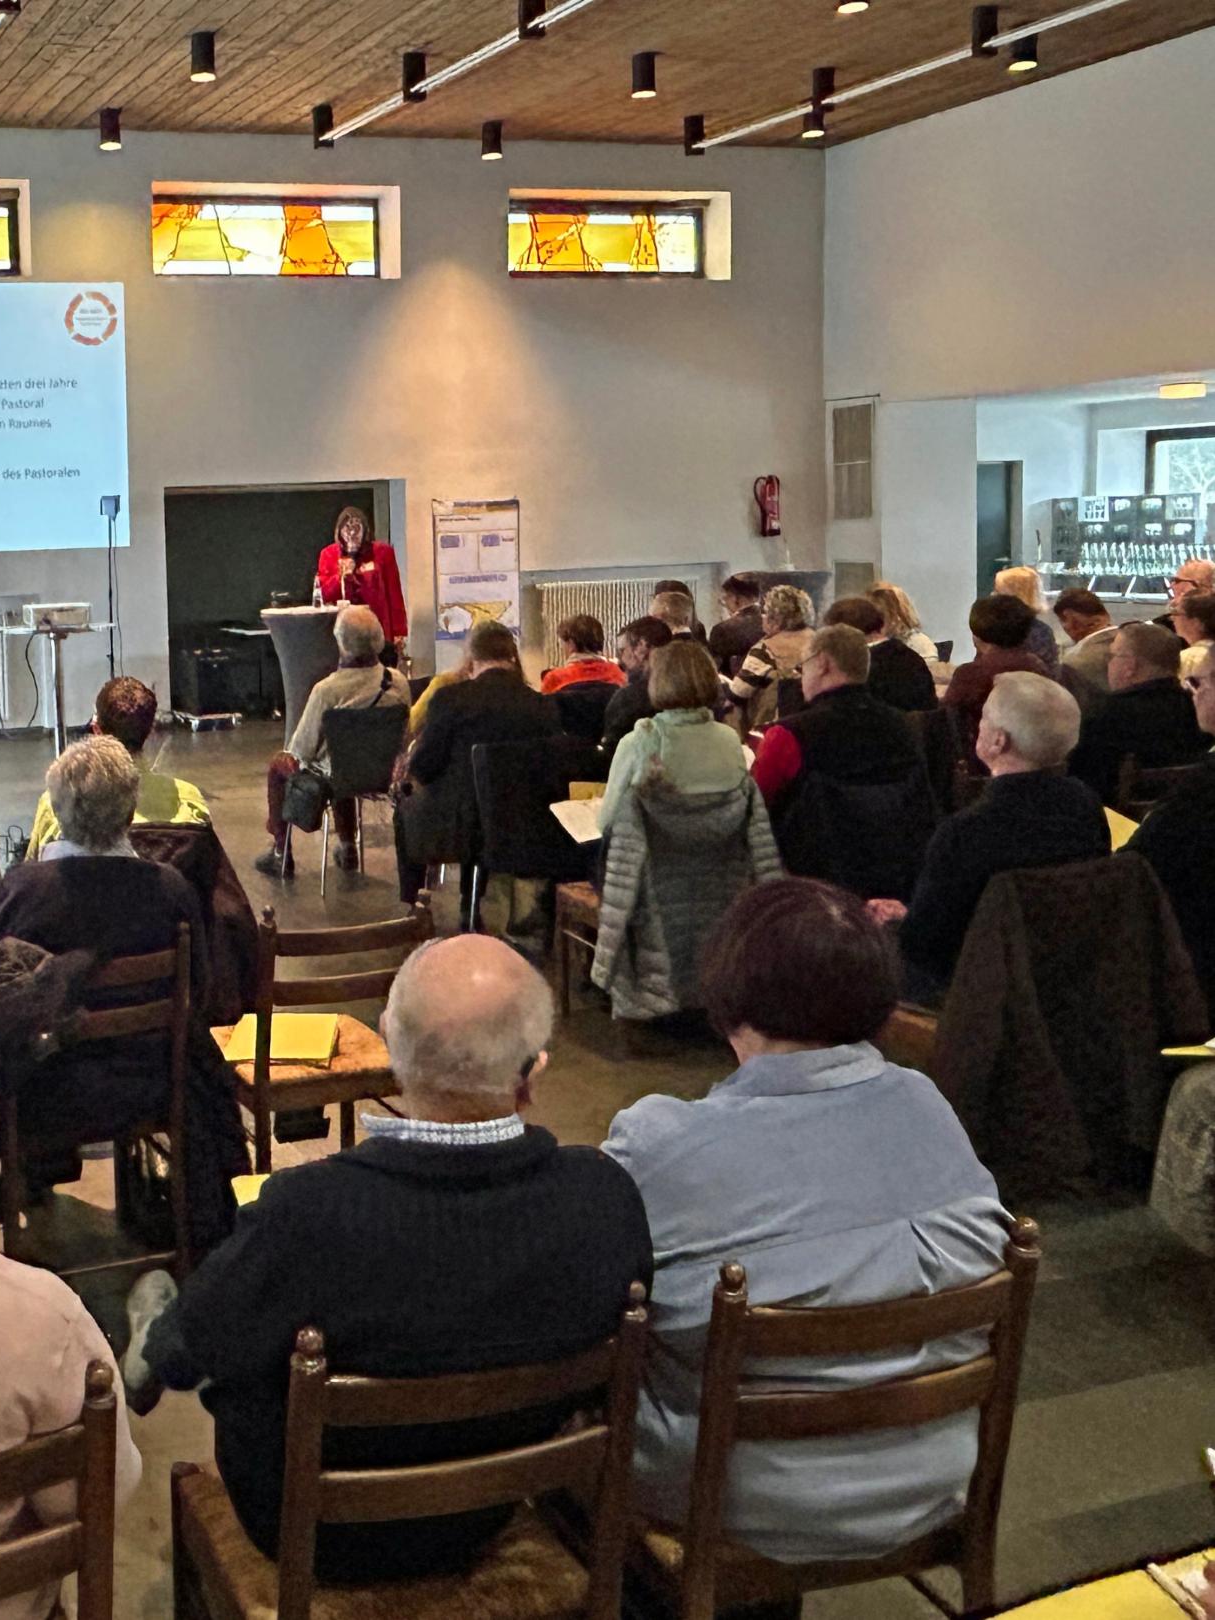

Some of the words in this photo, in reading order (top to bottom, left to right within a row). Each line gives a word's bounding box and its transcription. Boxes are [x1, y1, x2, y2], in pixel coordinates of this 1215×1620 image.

[24, 378, 46, 390] drei
[49, 377, 78, 389] Jahre
[1, 397, 45, 410] Pastoral
[8, 418, 52, 430] Raumes
[2, 468, 21, 480] des
[24, 467, 81, 479] Pastoralen
